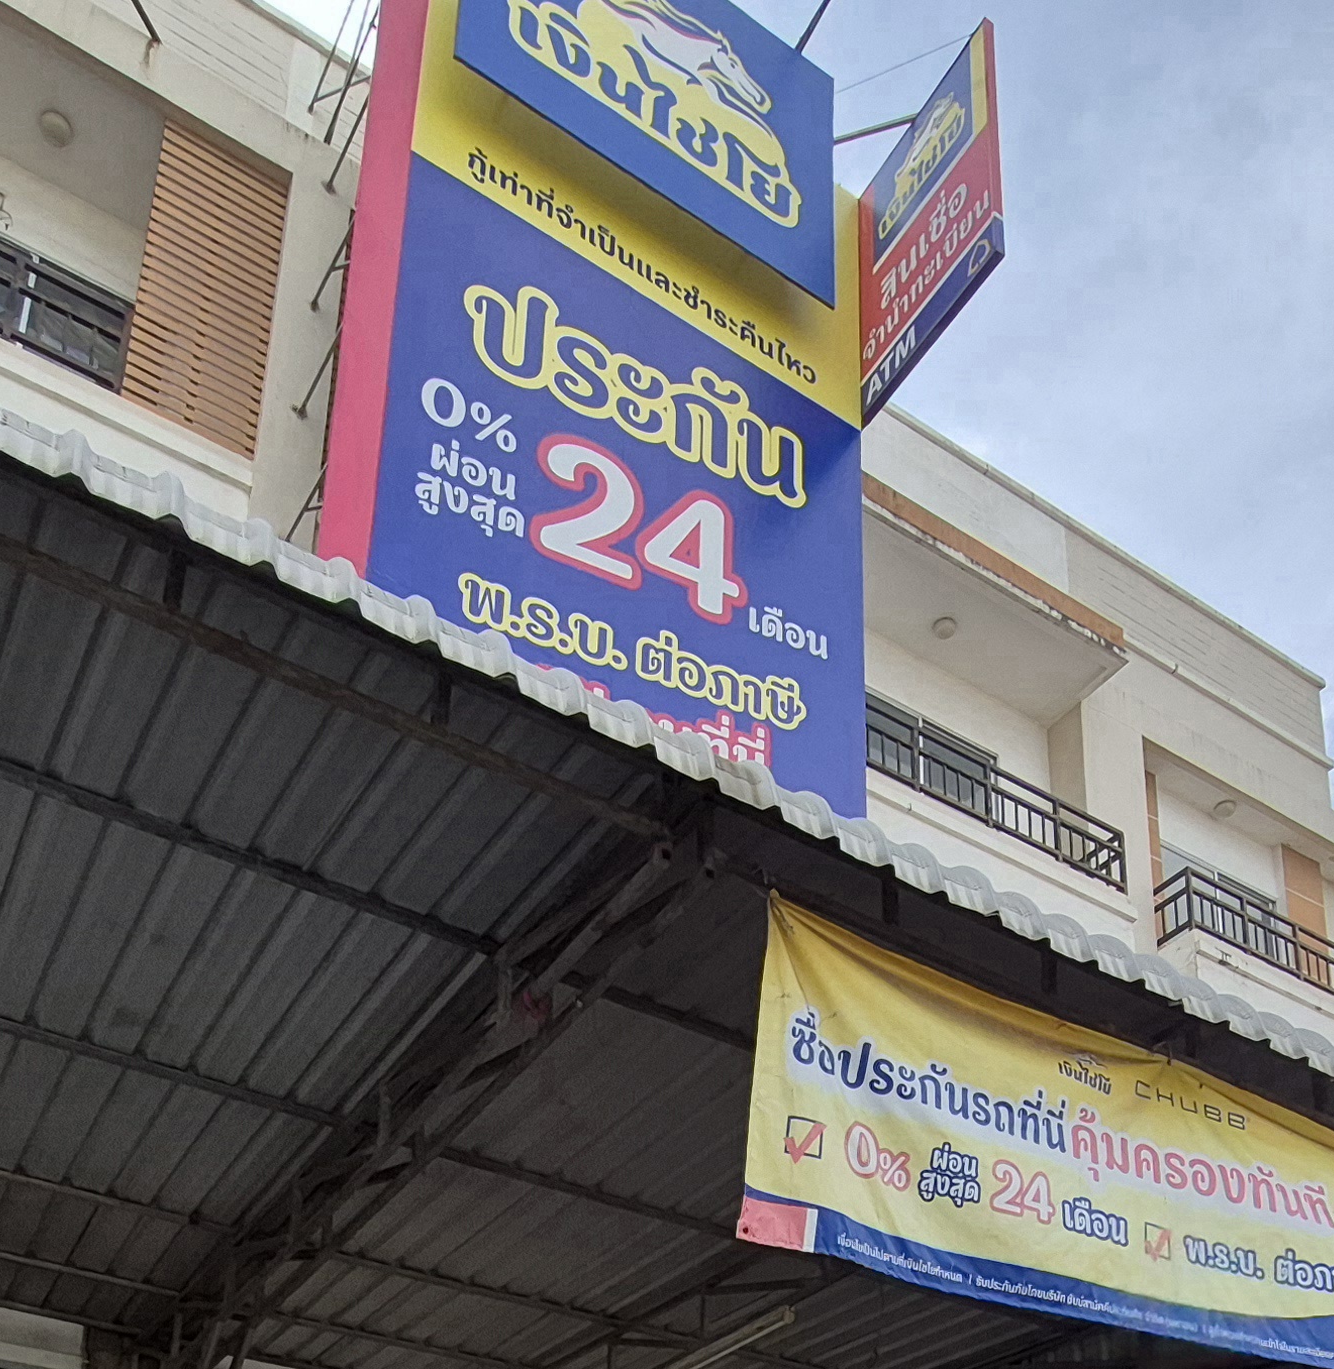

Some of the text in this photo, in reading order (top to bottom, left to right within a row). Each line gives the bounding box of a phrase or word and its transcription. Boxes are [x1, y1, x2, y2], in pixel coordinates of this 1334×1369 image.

[880, 183, 967, 309] สินเชื่อ
[464, 285, 806, 507] ประกัน
[866, 324, 916, 406] ATM
[420, 377, 519, 455] 0%
[429, 441, 517, 499] ผ่อน
[415, 472, 525, 539] สูงสุด
[530, 434, 748, 625] 24
[458, 572, 806, 730] พ.ร.บ. ต่อภาษี
[748, 605, 829, 660] เดือน
[1135, 1080, 1246, 1130] CHUBB
[844, 1120, 911, 1191] 0%
[930, 1142, 979, 1179] ผ่อน
[918, 1170, 981, 1208] สูงสุด
[989, 1159, 1056, 1225] 24
[1062, 1196, 1129, 1247] เดือน
[1183, 1235, 1265, 1280] พ.ร.บ.
